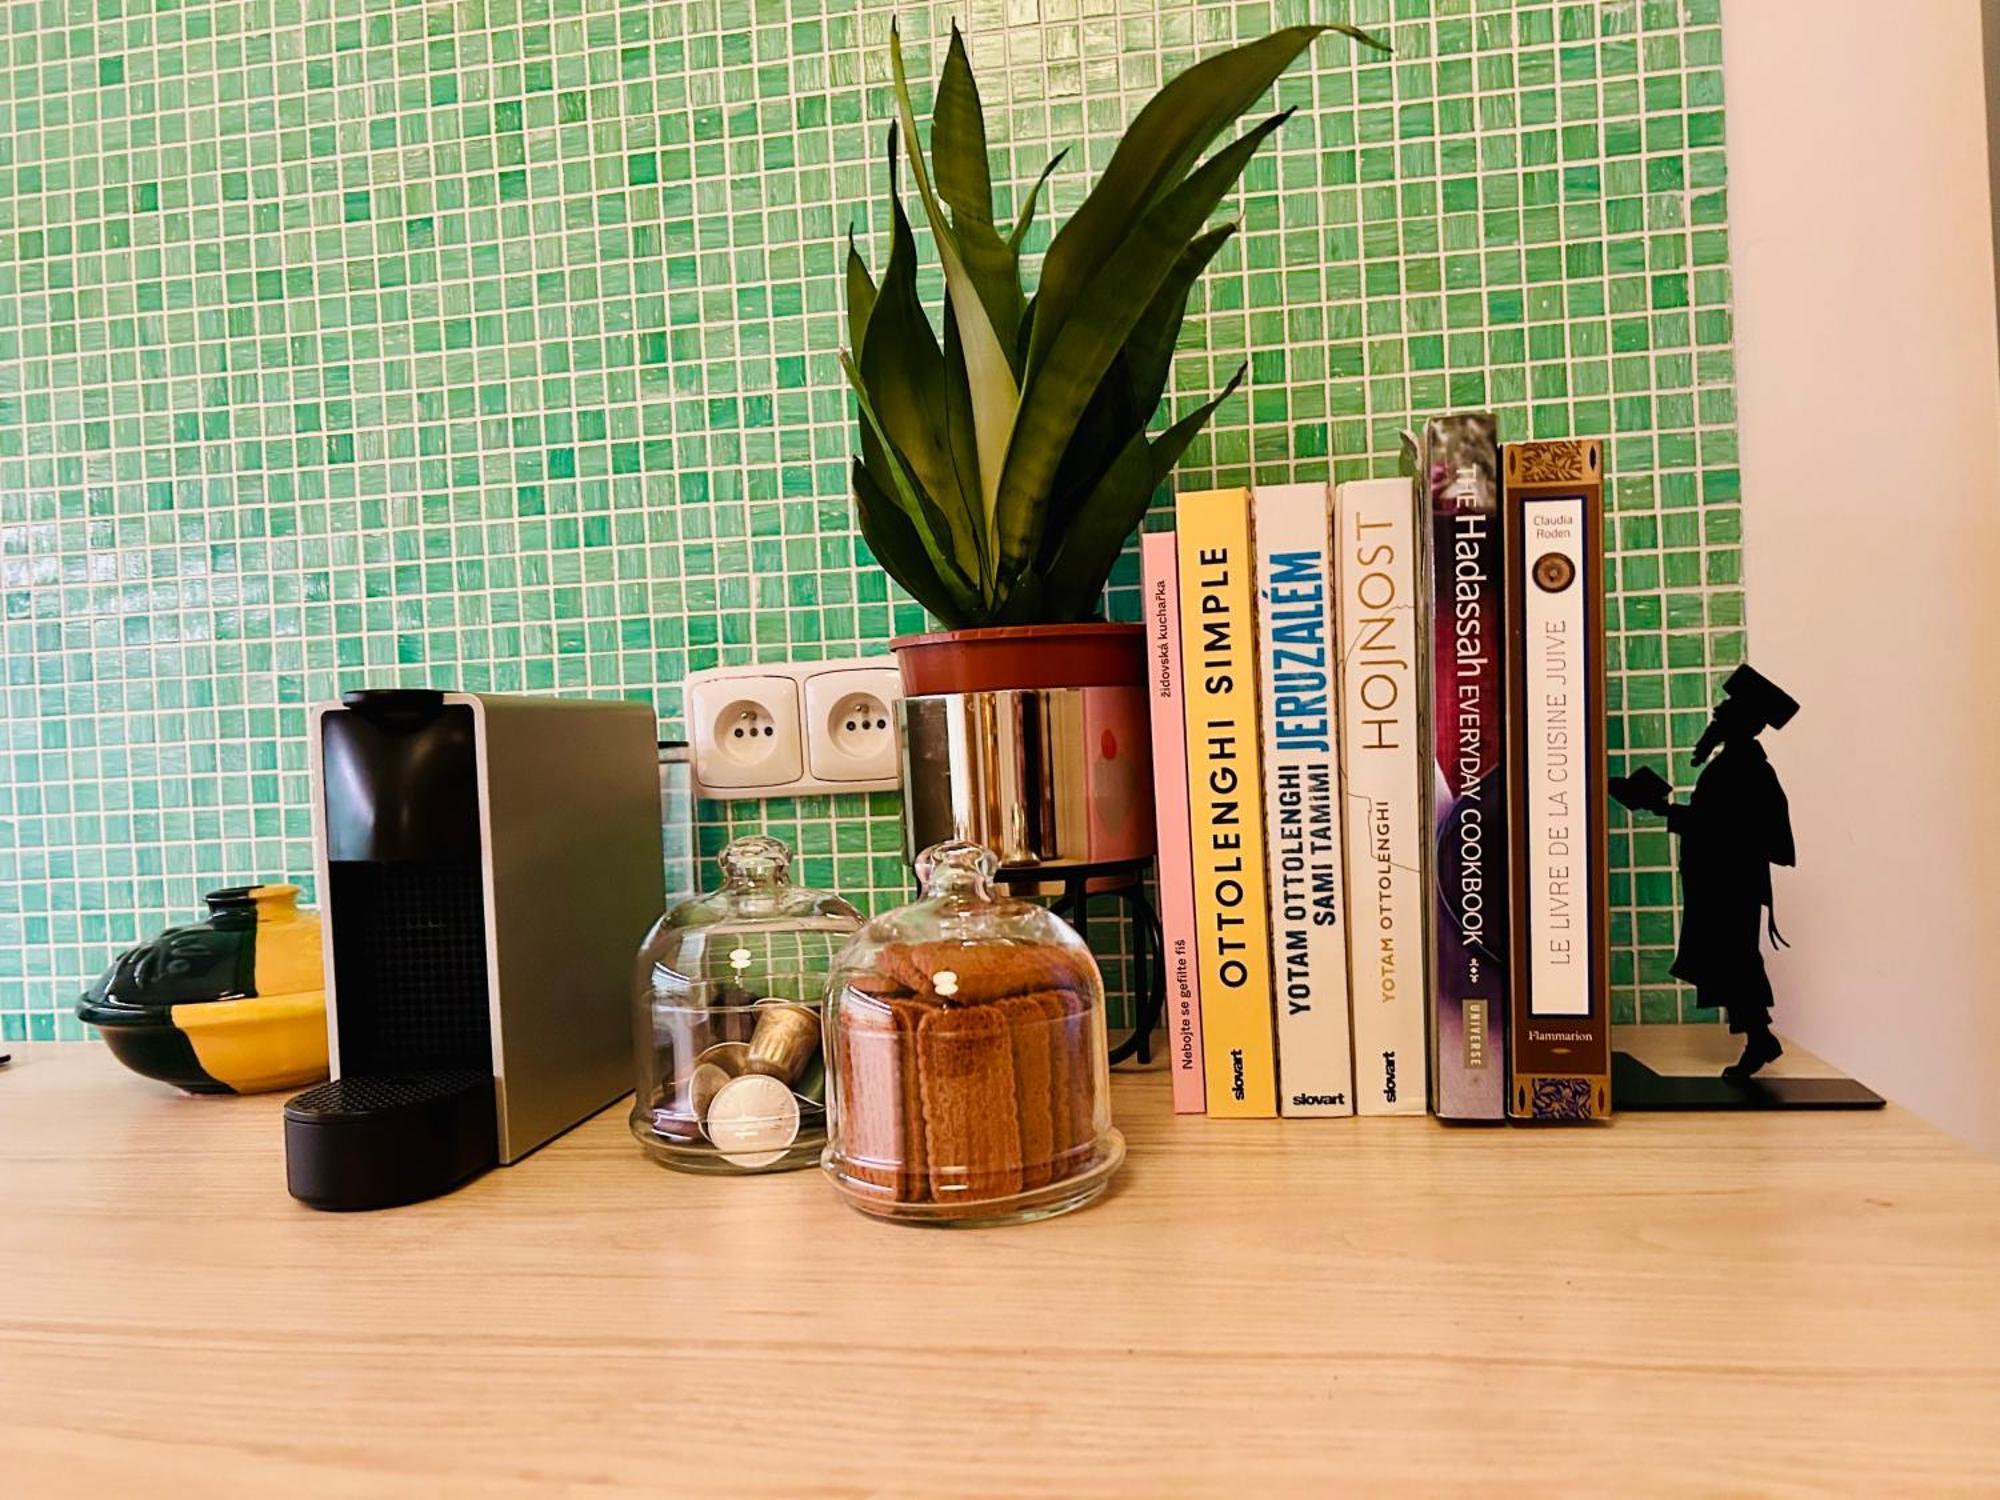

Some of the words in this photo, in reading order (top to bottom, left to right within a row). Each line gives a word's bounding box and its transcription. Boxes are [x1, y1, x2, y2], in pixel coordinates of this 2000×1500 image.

[1456, 463, 1477, 509] THE
[1533, 515, 1573, 527] Claudia
[1536, 528, 1571, 540] Roden
[1154, 579, 1168, 639] kuchařka
[1199, 548, 1234, 694] SIMPLE
[1455, 514, 1488, 677] Hadassah
[1261, 551, 1331, 753] JERUZALÉM
[1356, 511, 1407, 750] HOJNOST
[1545, 620, 1567, 685] JUIVE
[1158, 641, 1172, 699] židovská
[1458, 685, 1481, 801] EVERYDAY
[1547, 694, 1568, 784] CUISINE
[1307, 763, 1333, 855] TAMIMI
[1548, 791, 1568, 817] LA
[1206, 720, 1248, 989] OTTOLENGHI
[1277, 764, 1308, 921] OTTOLENGHI
[1375, 801, 1393, 930] OTTOLENGHI
[1549, 827, 1569, 856] DE
[1311, 863, 1336, 927] SAMI
[1460, 808, 1483, 946] COOKBOOK
[1549, 866, 1570, 929] LIVRE
[1174, 939, 1186, 955] fiš
[1285, 929, 1312, 1016] YOTAM
[1381, 937, 1397, 1004] YOTAM
[1550, 939, 1571, 965] LE
[1176, 959, 1192, 999] gefilte
[1180, 1001, 1191, 1016] se
[1181, 1018, 1195, 1070] Nebojte
[1469, 1004, 1482, 1066] UNIVERSE
[1527, 1029, 1593, 1042] Flammarion
[1230, 1048, 1246, 1101] slovart
[1292, 1092, 1345, 1107] slovart
[1381, 1050, 1398, 1104] slovart
